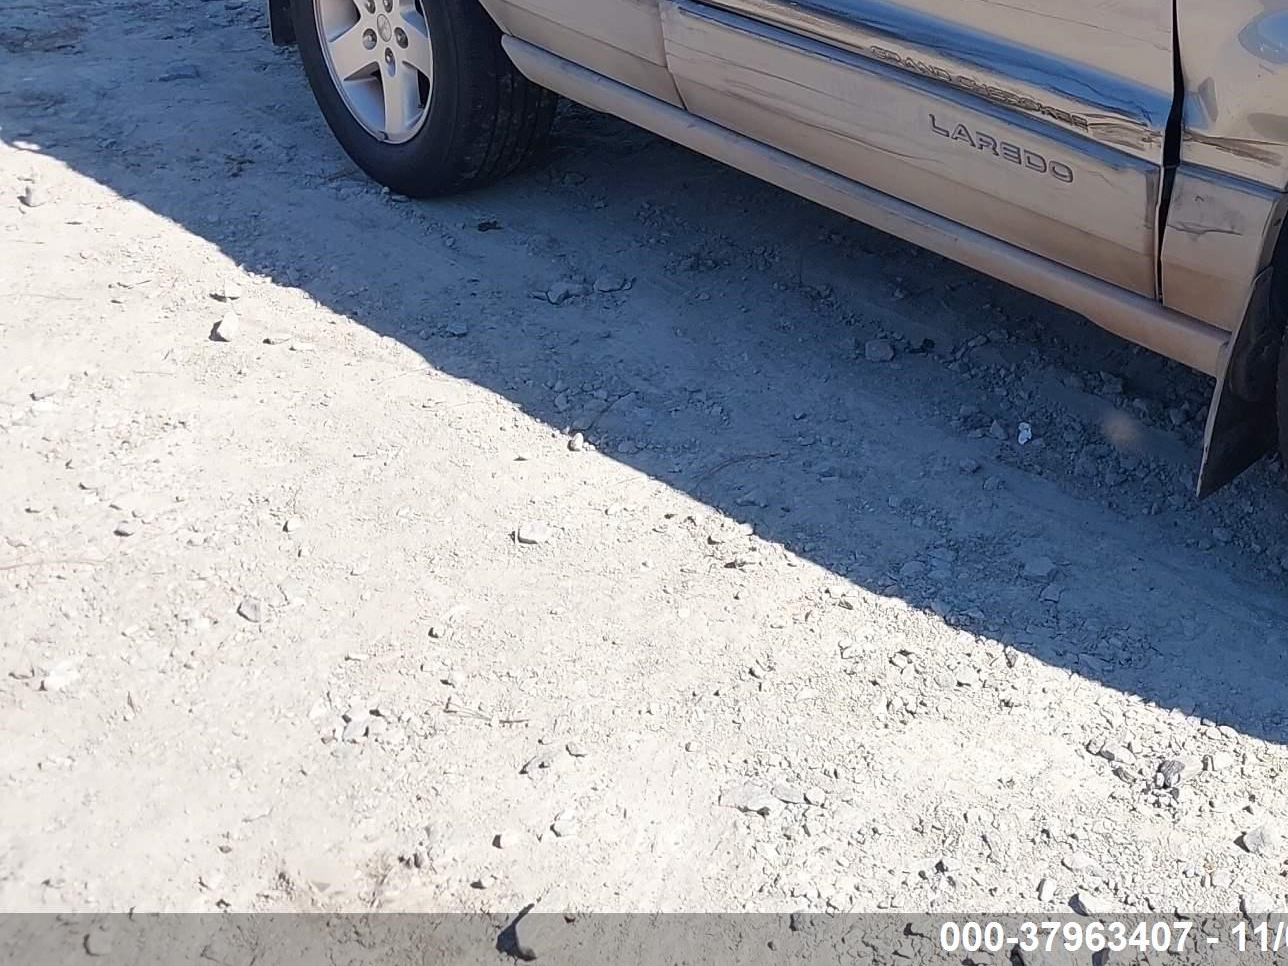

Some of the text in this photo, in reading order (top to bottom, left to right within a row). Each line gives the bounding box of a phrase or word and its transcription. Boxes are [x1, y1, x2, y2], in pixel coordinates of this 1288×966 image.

[871, 45, 1089, 132] GRAND CHEROKEE
[929, 114, 1073, 183] LAREDO
